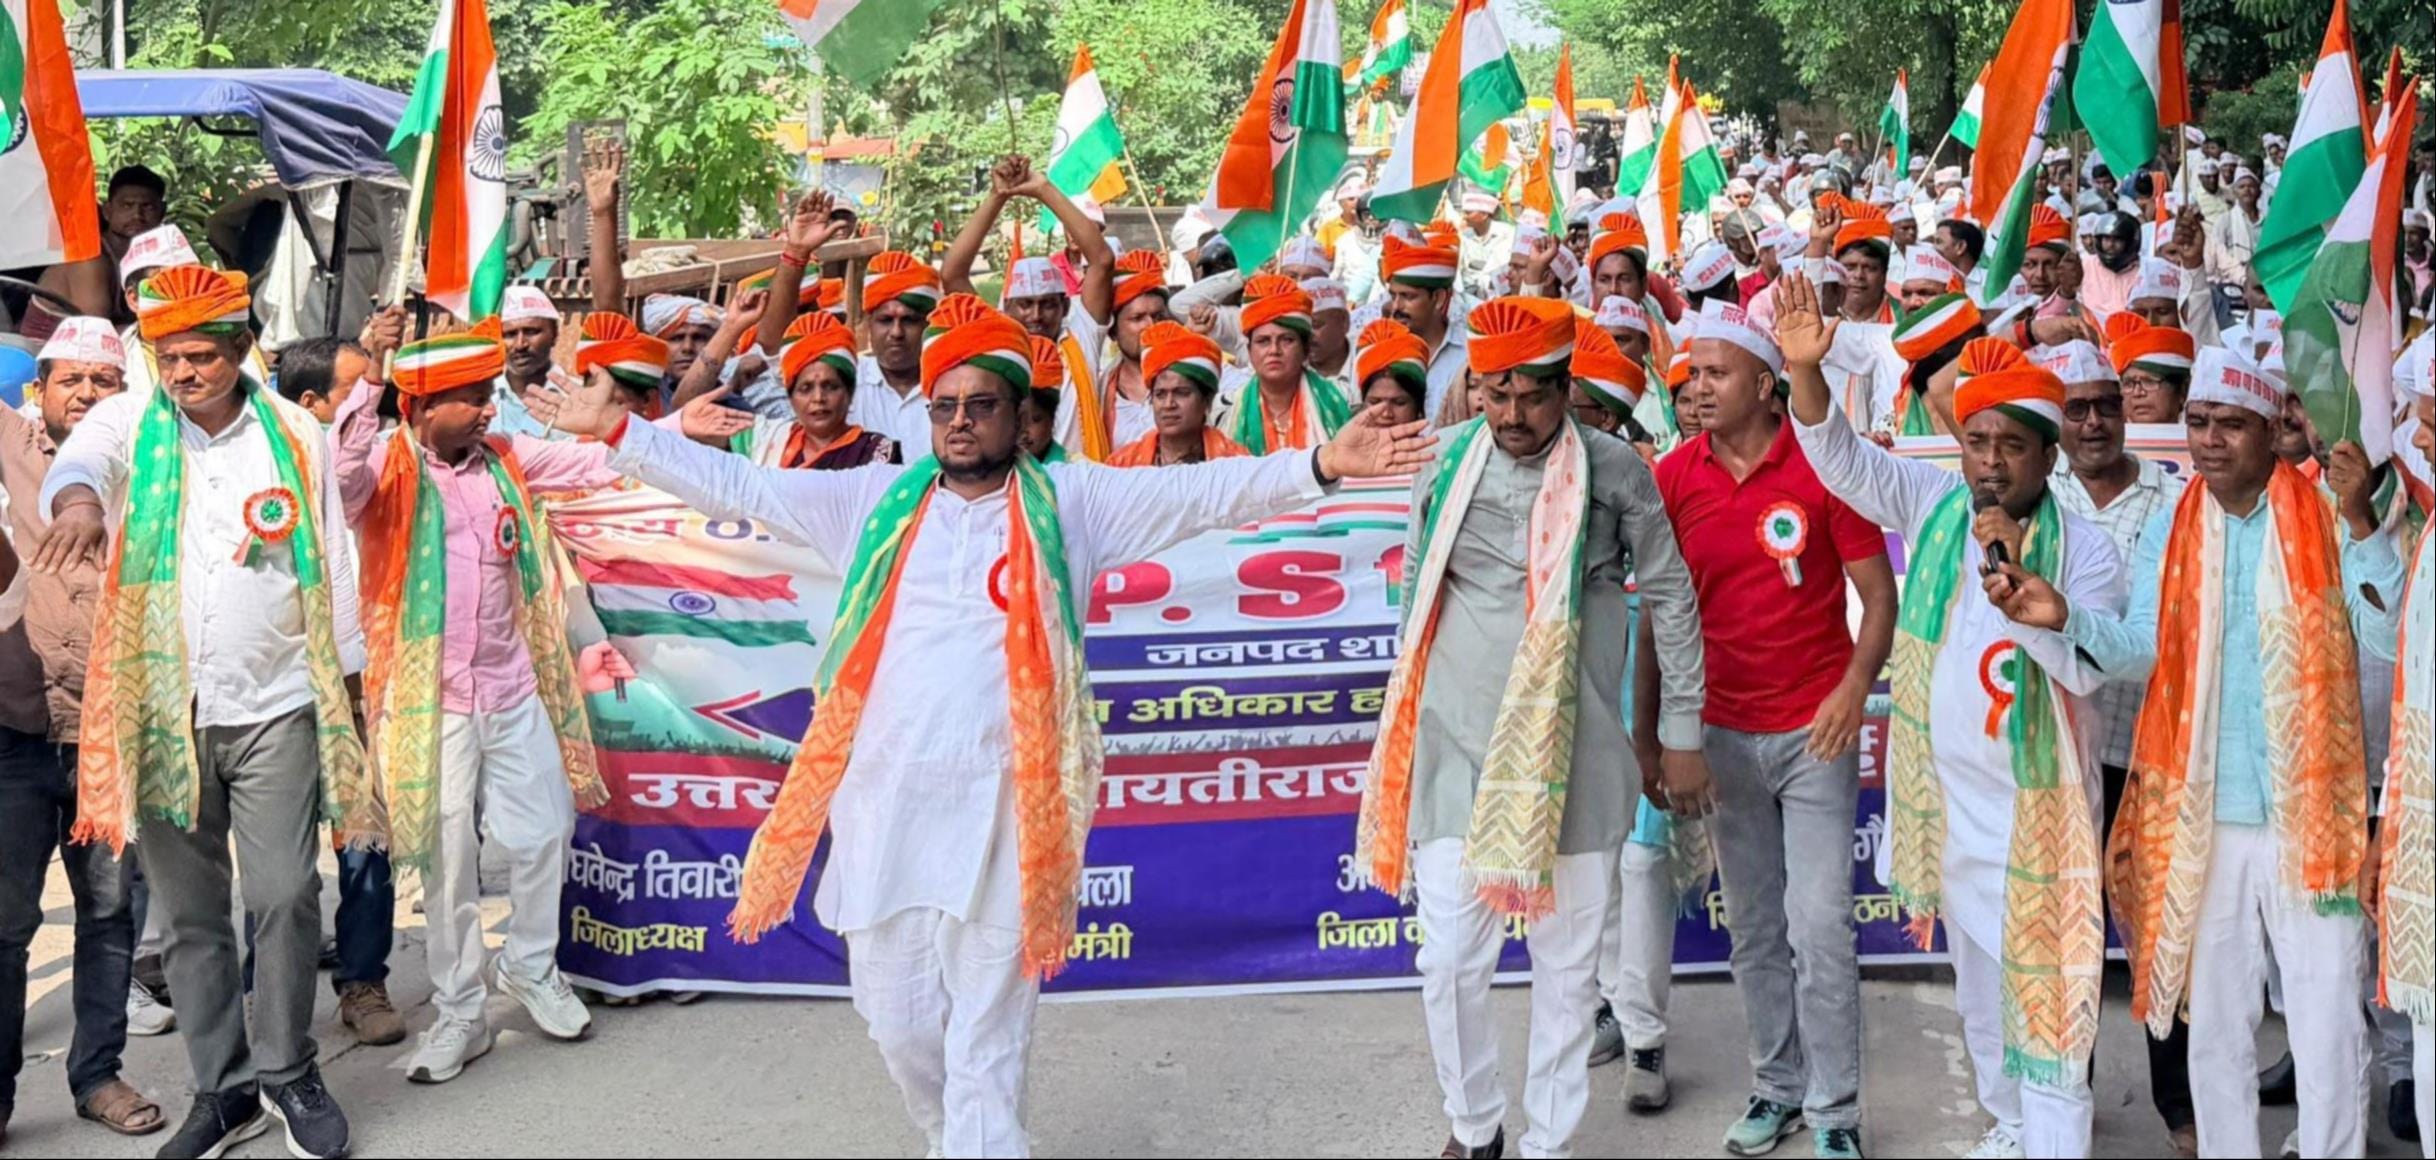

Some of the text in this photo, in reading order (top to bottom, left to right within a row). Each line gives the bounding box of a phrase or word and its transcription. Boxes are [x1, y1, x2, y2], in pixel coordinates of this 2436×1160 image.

[1146, 637, 1328, 667] जनपद
[1127, 686, 1338, 723] अधिकार
[643, 849, 744, 901] तिवारी
[570, 905, 707, 956] जिलाध्यक्ष
[1317, 911, 1399, 950] जिला
